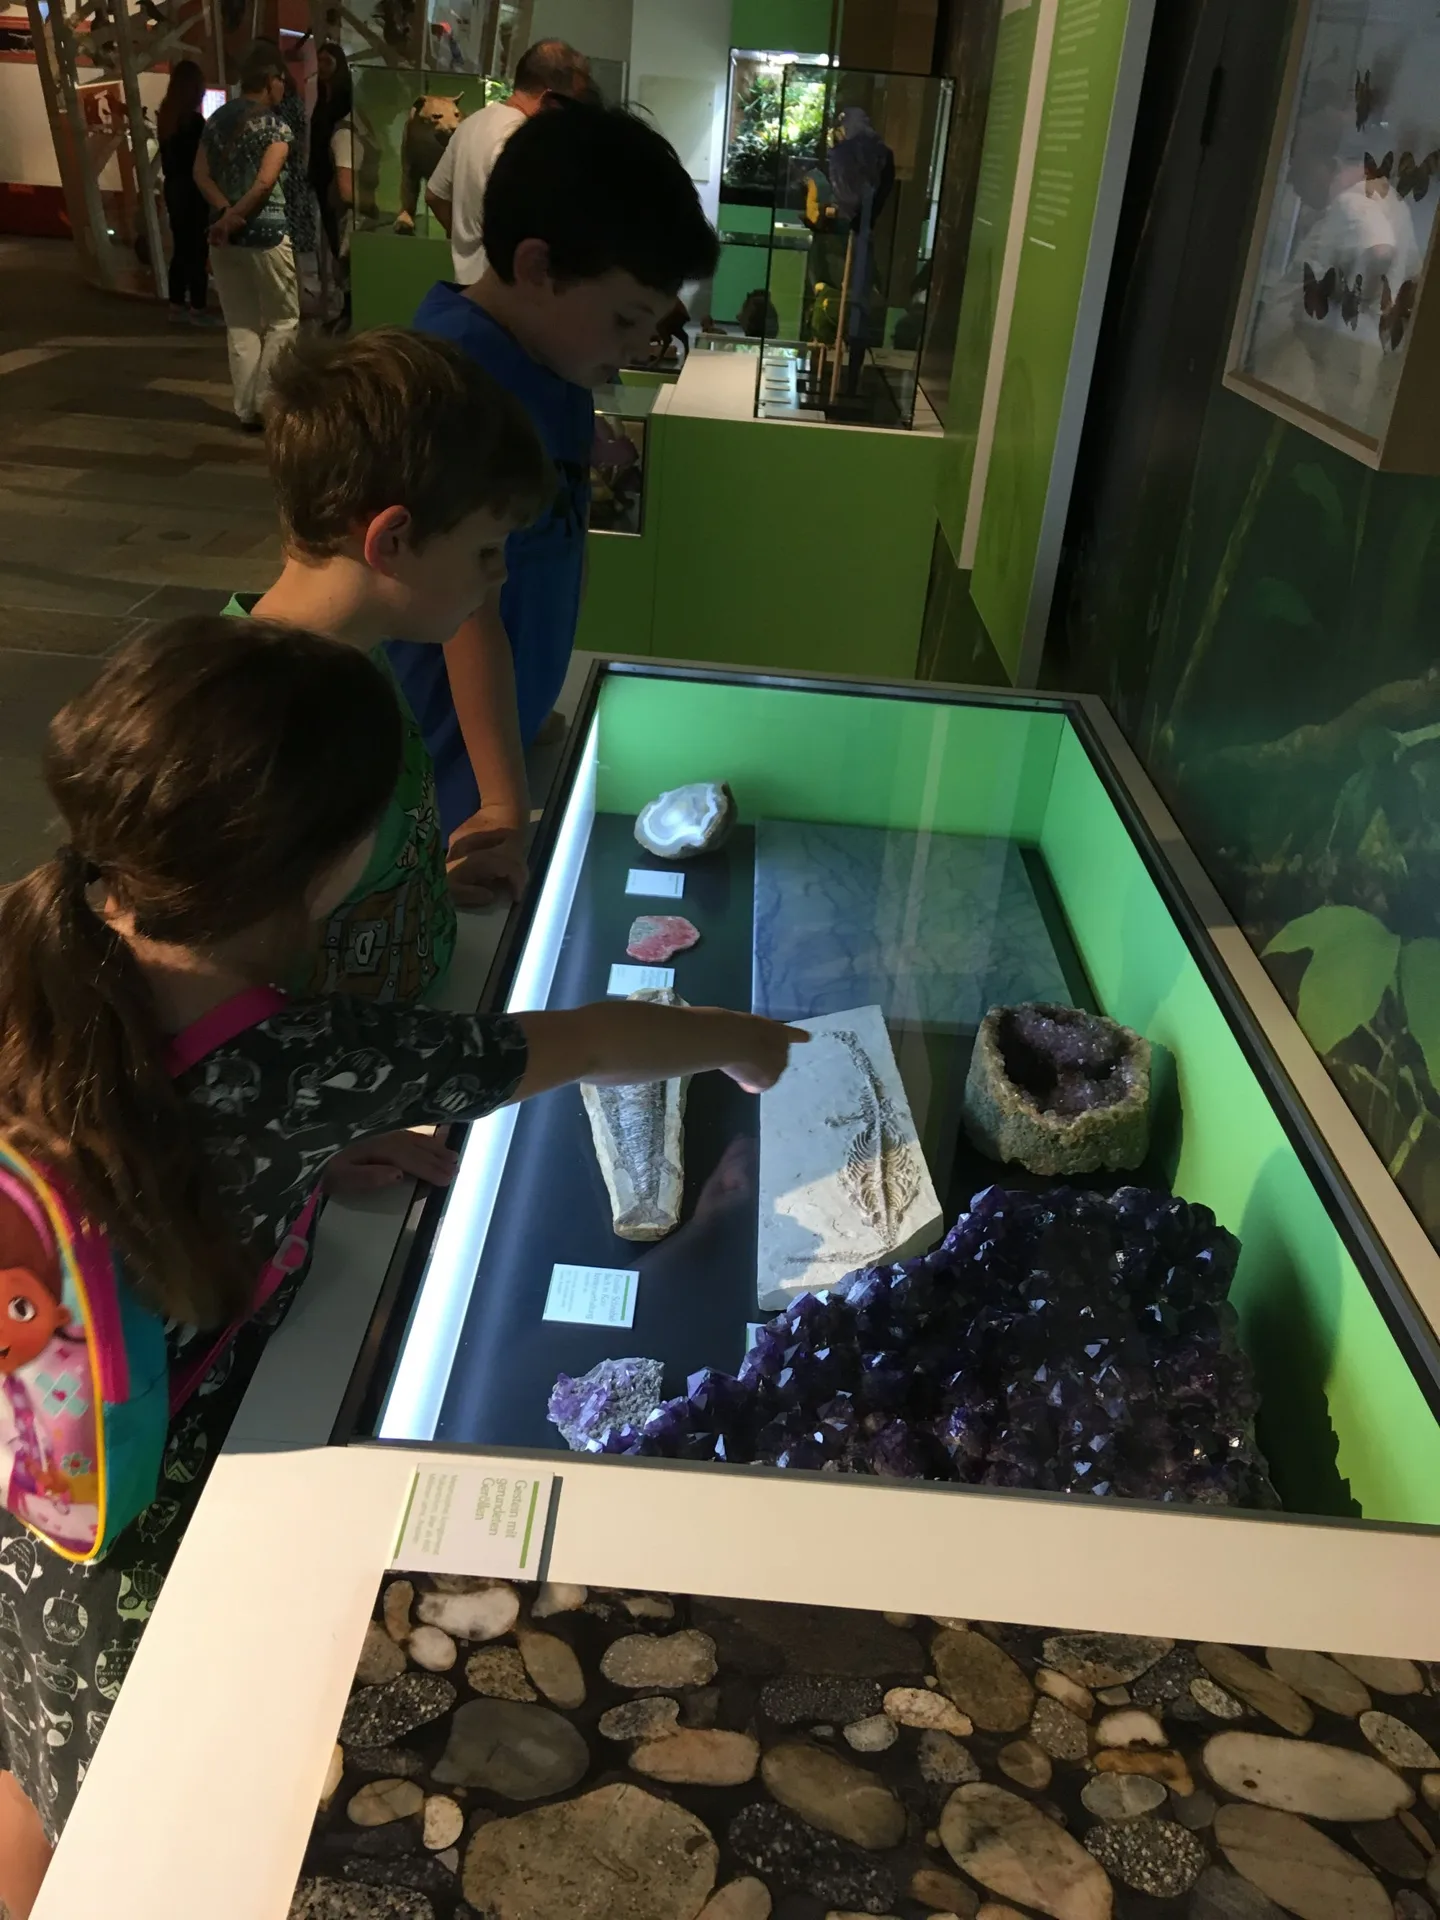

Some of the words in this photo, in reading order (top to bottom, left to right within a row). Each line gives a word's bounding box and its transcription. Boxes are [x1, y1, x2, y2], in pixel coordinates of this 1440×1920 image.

[475, 1477, 495, 1521] Geröllen
[488, 1478, 508, 1536] gerundeten
[508, 1479, 527, 1519] Gestein
[504, 1520, 516, 1538] mit
